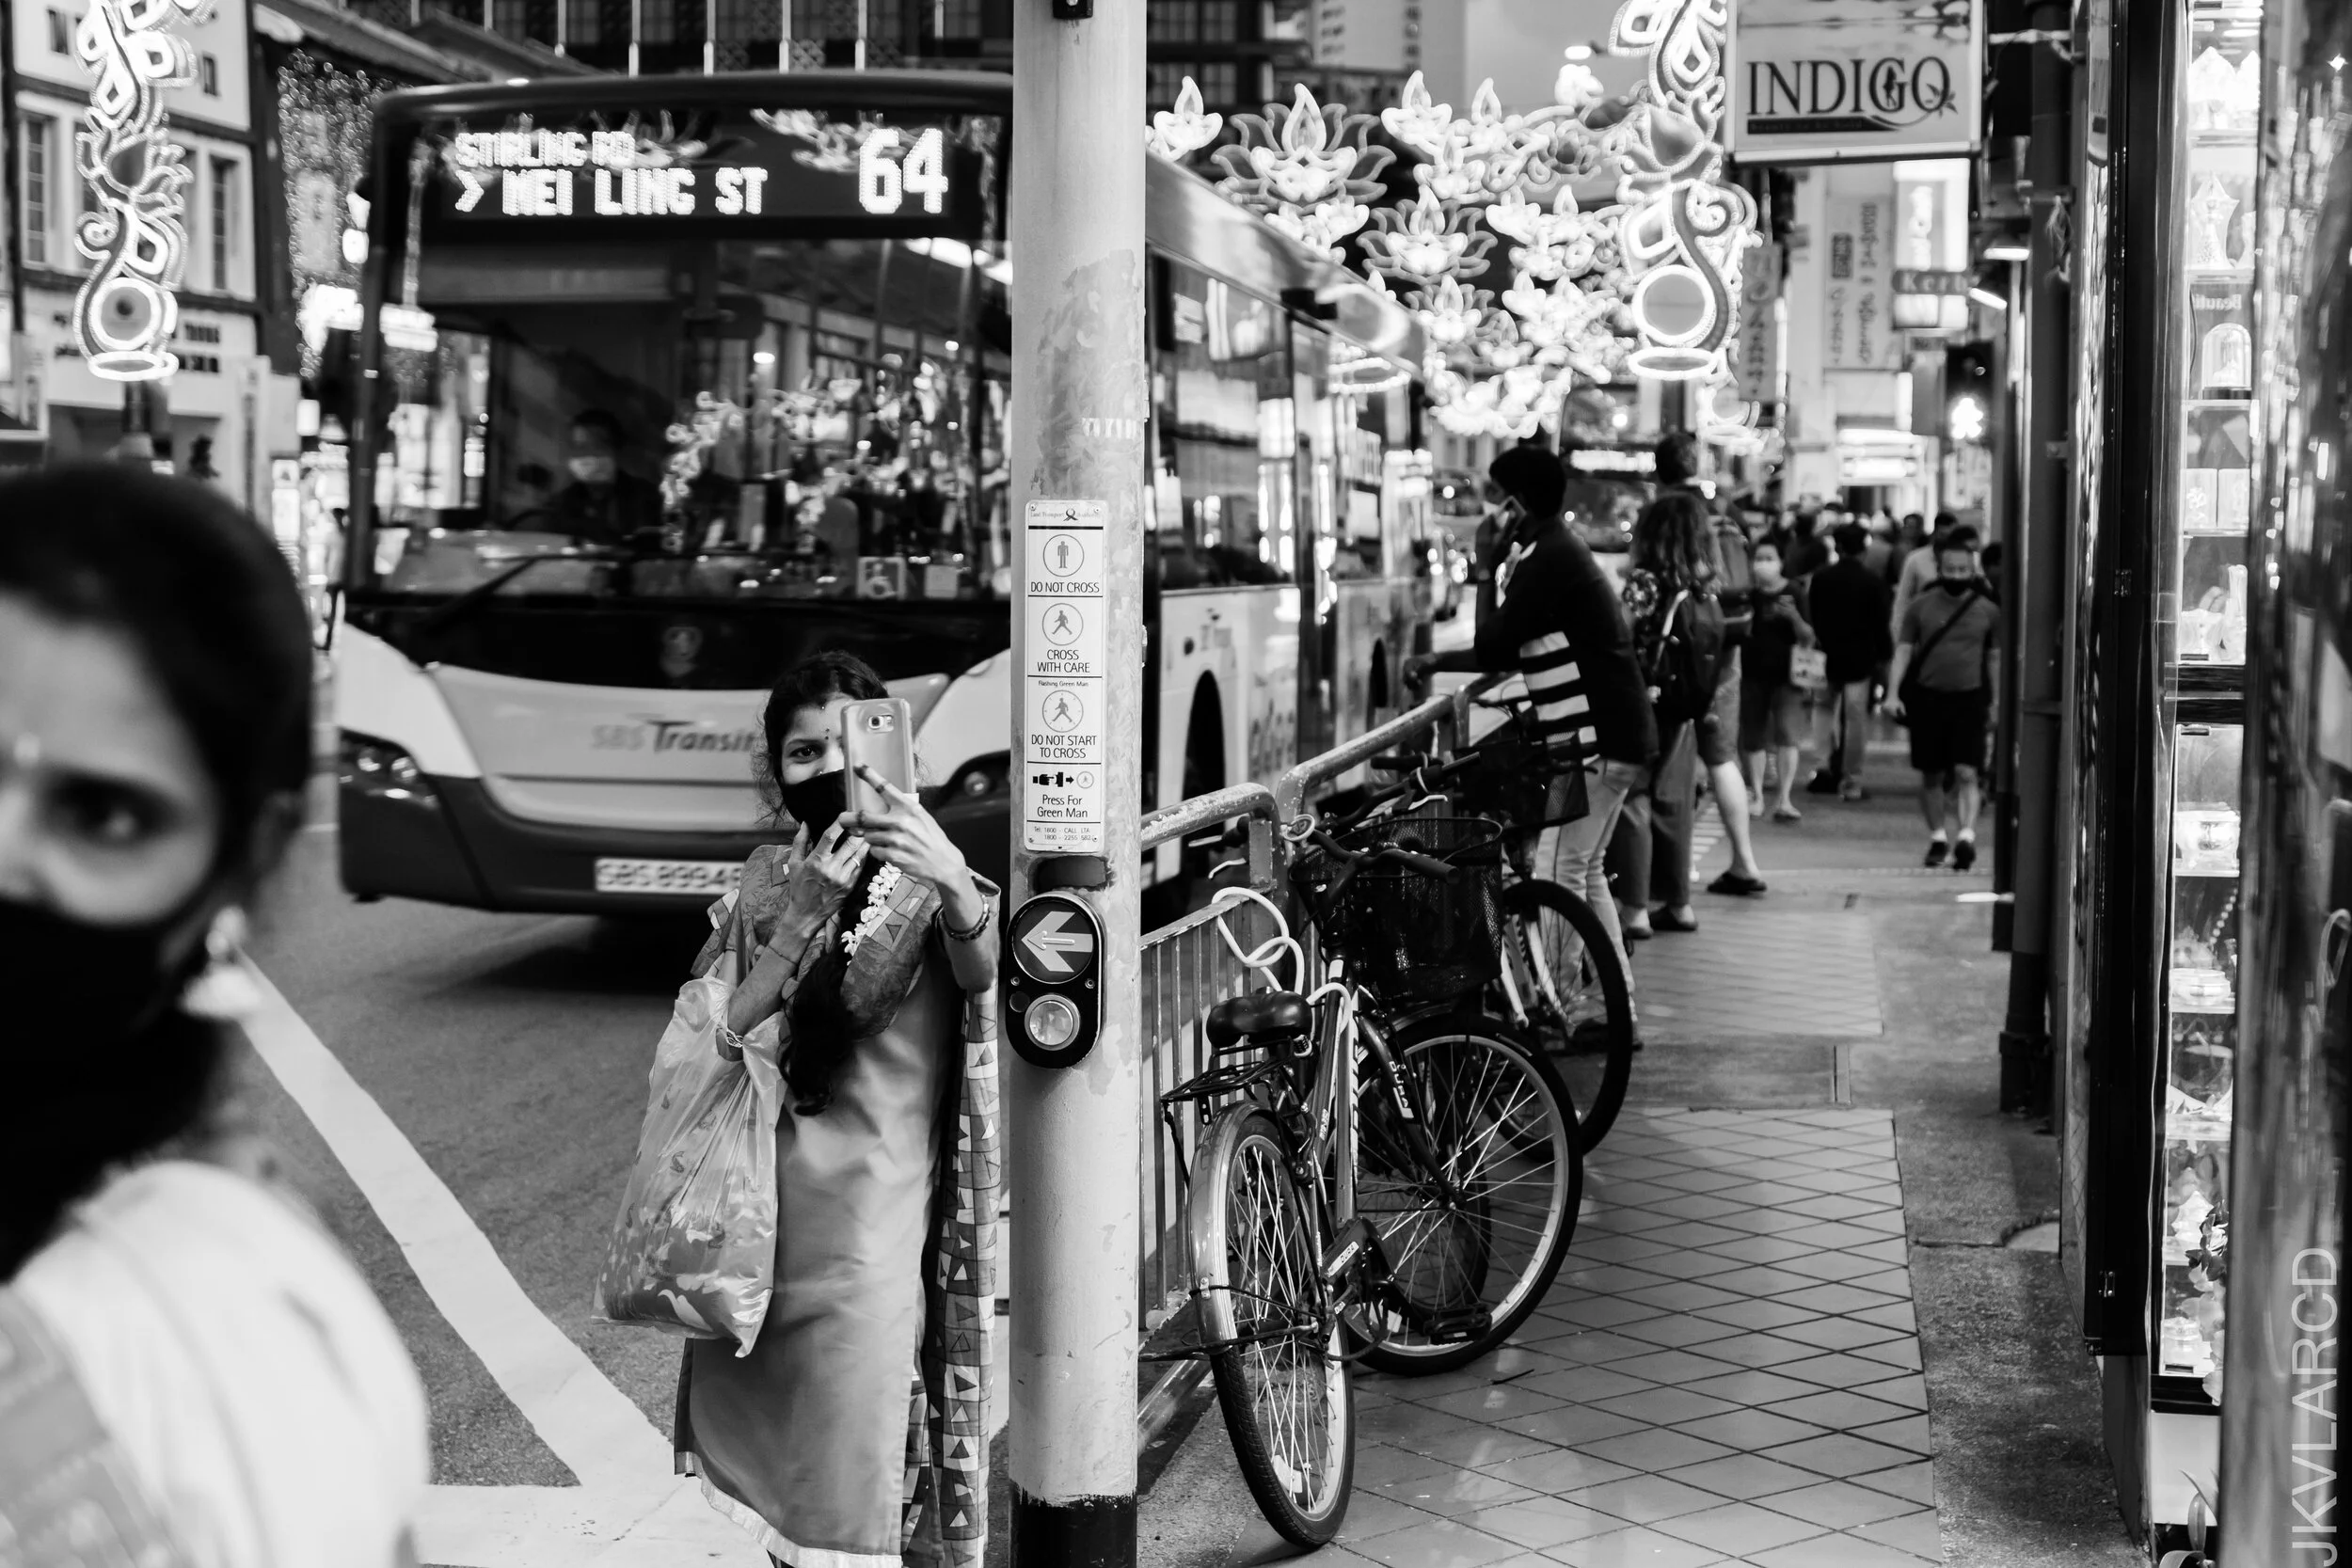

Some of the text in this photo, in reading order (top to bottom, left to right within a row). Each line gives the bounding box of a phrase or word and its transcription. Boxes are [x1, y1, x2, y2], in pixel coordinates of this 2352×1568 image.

[1747, 56, 1951, 115] INDIGO
[859, 128, 948, 215] 64
[502, 166, 769, 216] MEI LING ST
[1030, 581, 1100, 594] DO NOT CROSS
[1046, 649, 1080, 660] CROSS
[1037, 661, 1090, 673] WITH CARE
[646, 720, 756, 754] Transit
[1031, 734, 1097, 746] DO NOT START
[1040, 747, 1087, 759] TO CROSS
[1041, 794, 1083, 805] Press For
[1037, 806, 1088, 818] Green Man
